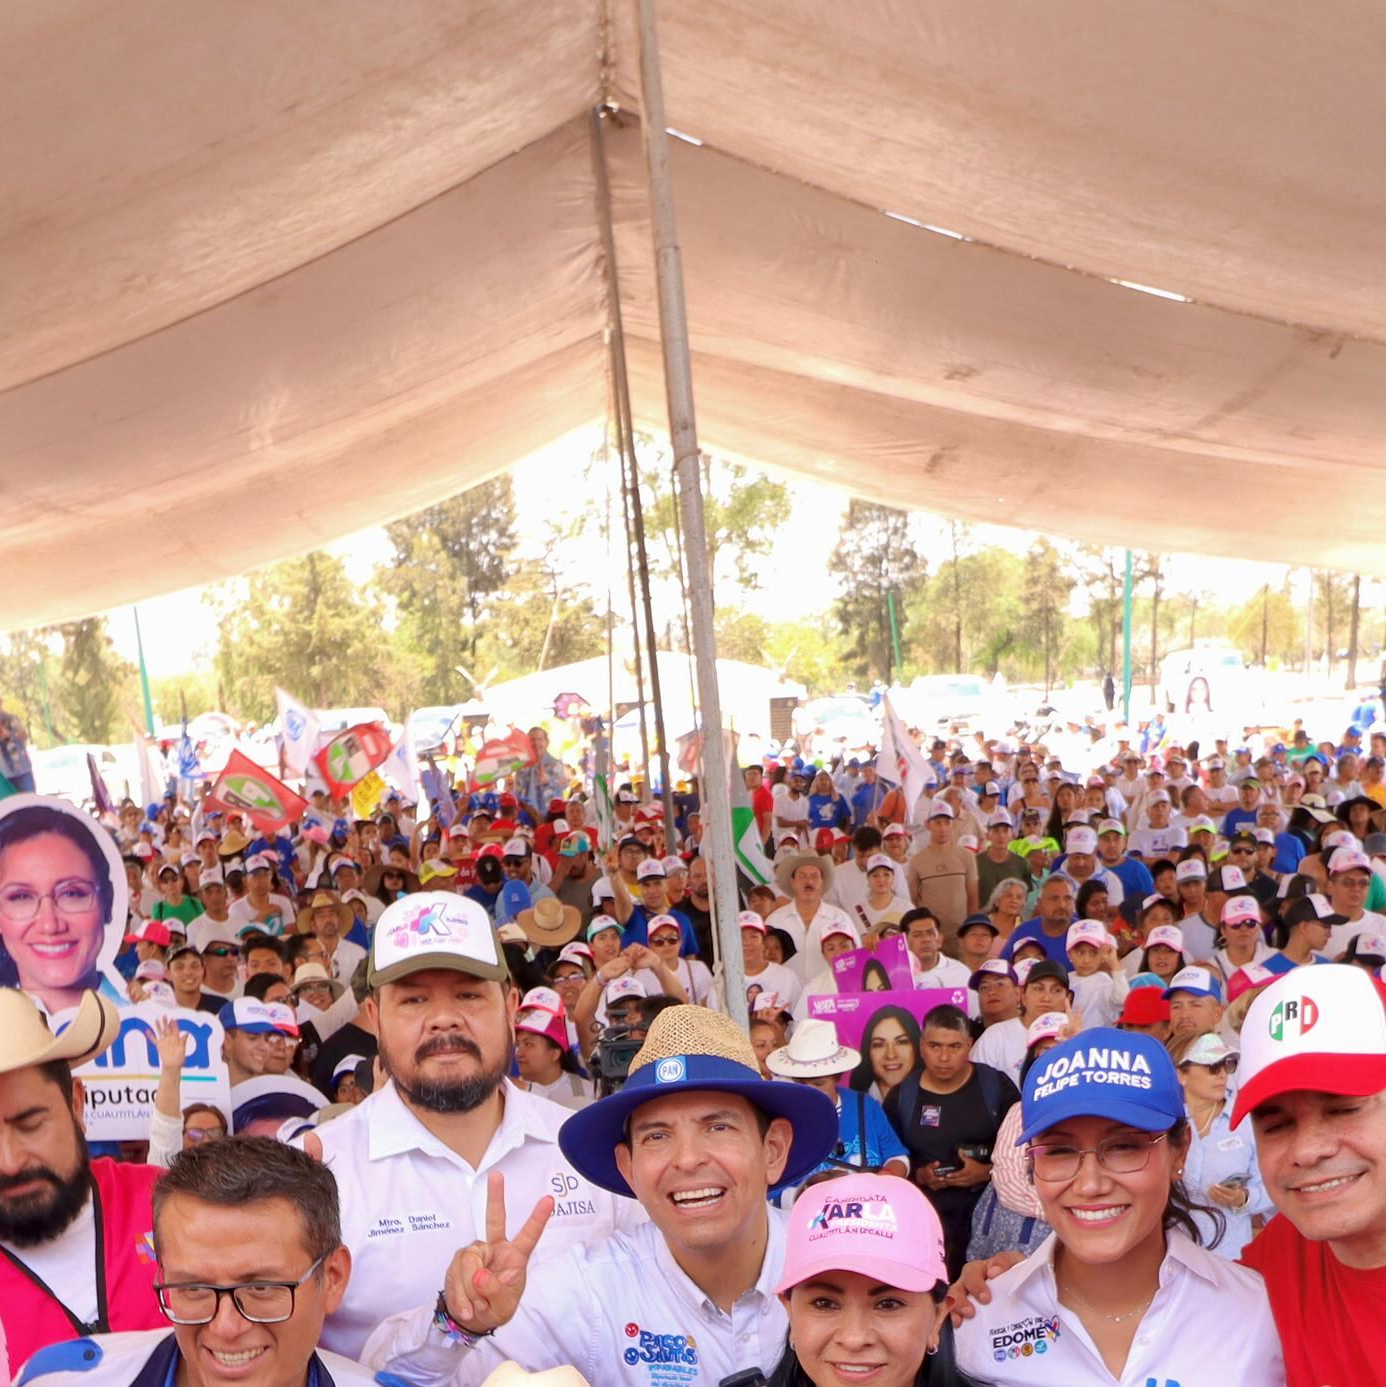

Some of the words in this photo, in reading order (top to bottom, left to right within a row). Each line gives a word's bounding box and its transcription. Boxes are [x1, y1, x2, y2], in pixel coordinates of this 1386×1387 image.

[1269, 997, 1317, 1038] PRI
[662, 1064, 678, 1077] PAN
[1037, 1048, 1151, 1085] JOANNA
[1033, 1073, 1079, 1102] FELIPE
[1082, 1071, 1151, 1089] TORRES
[551, 1173, 579, 1197] SJD
[825, 1195, 888, 1204] CANDIDATA
[408, 1214, 437, 1223] Daniel
[860, 1228, 893, 1239] IZCALLI
